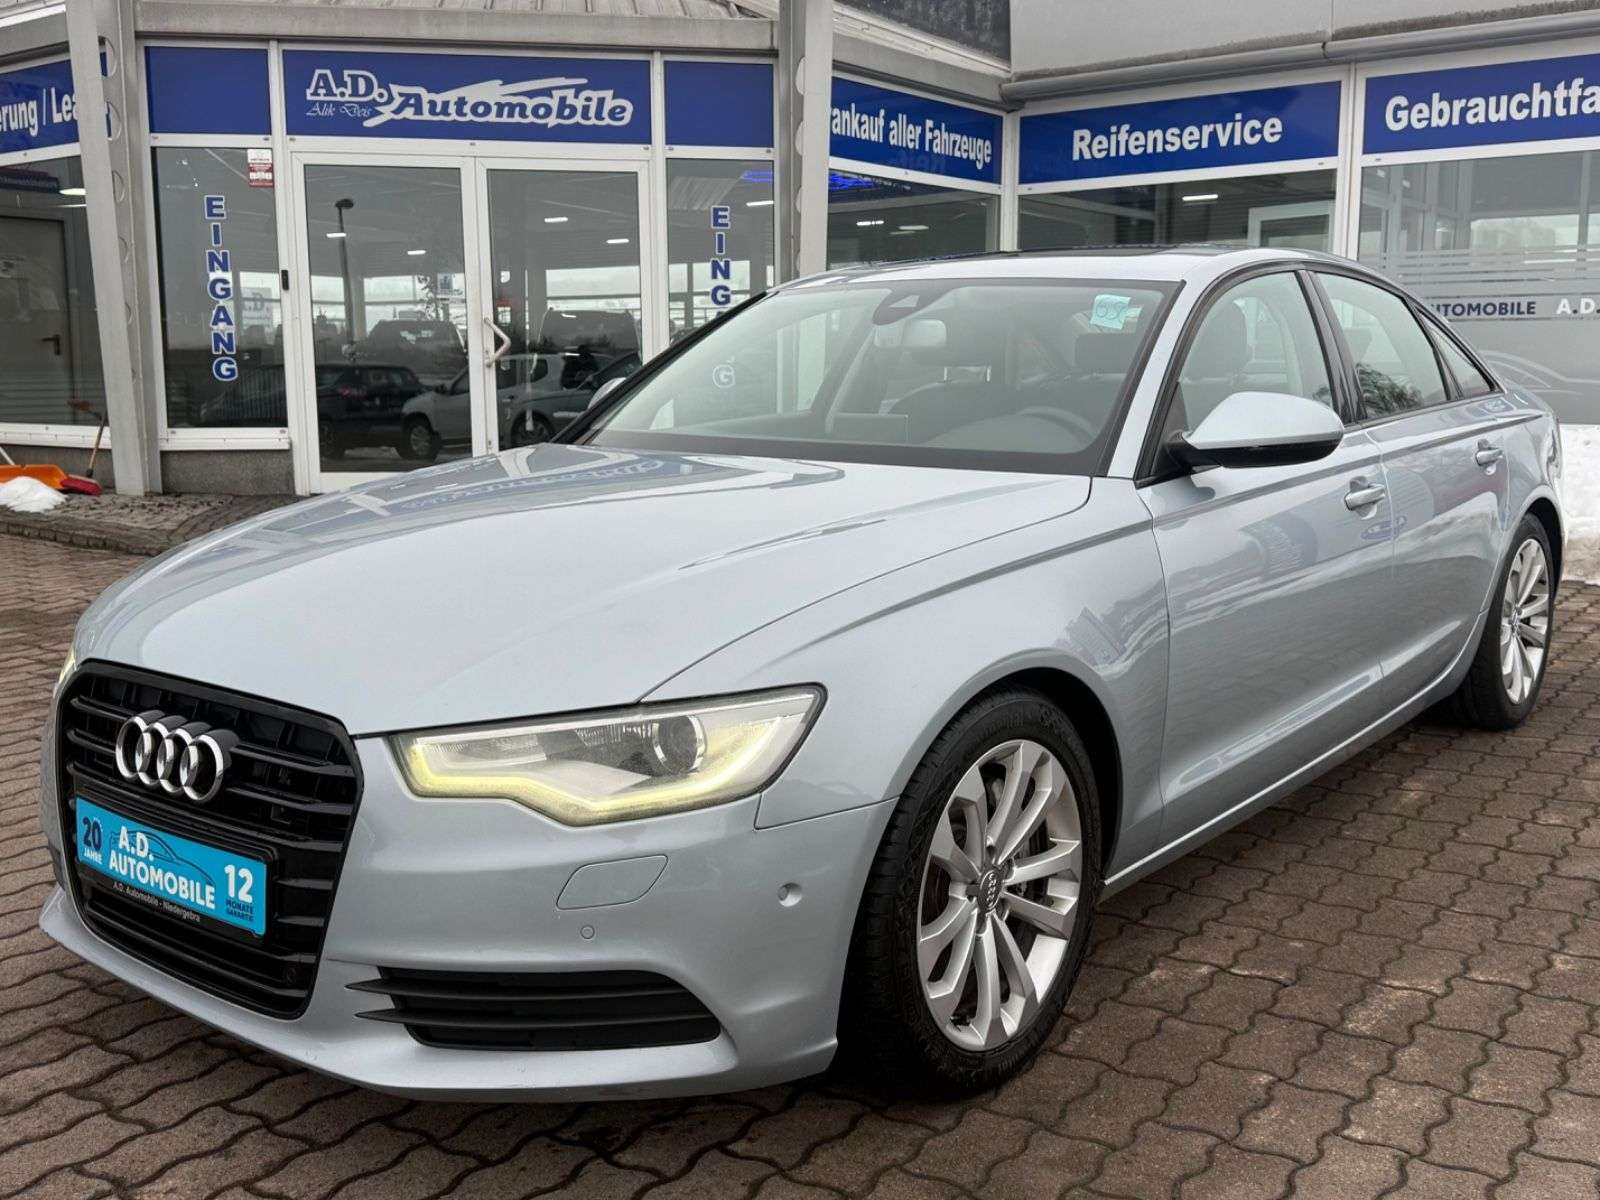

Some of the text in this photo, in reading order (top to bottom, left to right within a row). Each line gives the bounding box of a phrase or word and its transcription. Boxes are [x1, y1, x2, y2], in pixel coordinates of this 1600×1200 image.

[0, 100, 39, 137] rung
[306, 69, 634, 128] A.D. Automobile
[1384, 78, 1600, 131] Gebrauchtfa
[830, 103, 886, 143] ankauf
[889, 113, 922, 150] aller
[925, 119, 992, 170] Fahrzeuge
[1072, 112, 1283, 161] Reifenservice
[204, 195, 238, 381] EINGANG
[82, 816, 103, 851] 20
[118, 825, 154, 861] A.D.
[108, 849, 216, 910] AUTOMOBILE
[224, 864, 253, 904] 12
